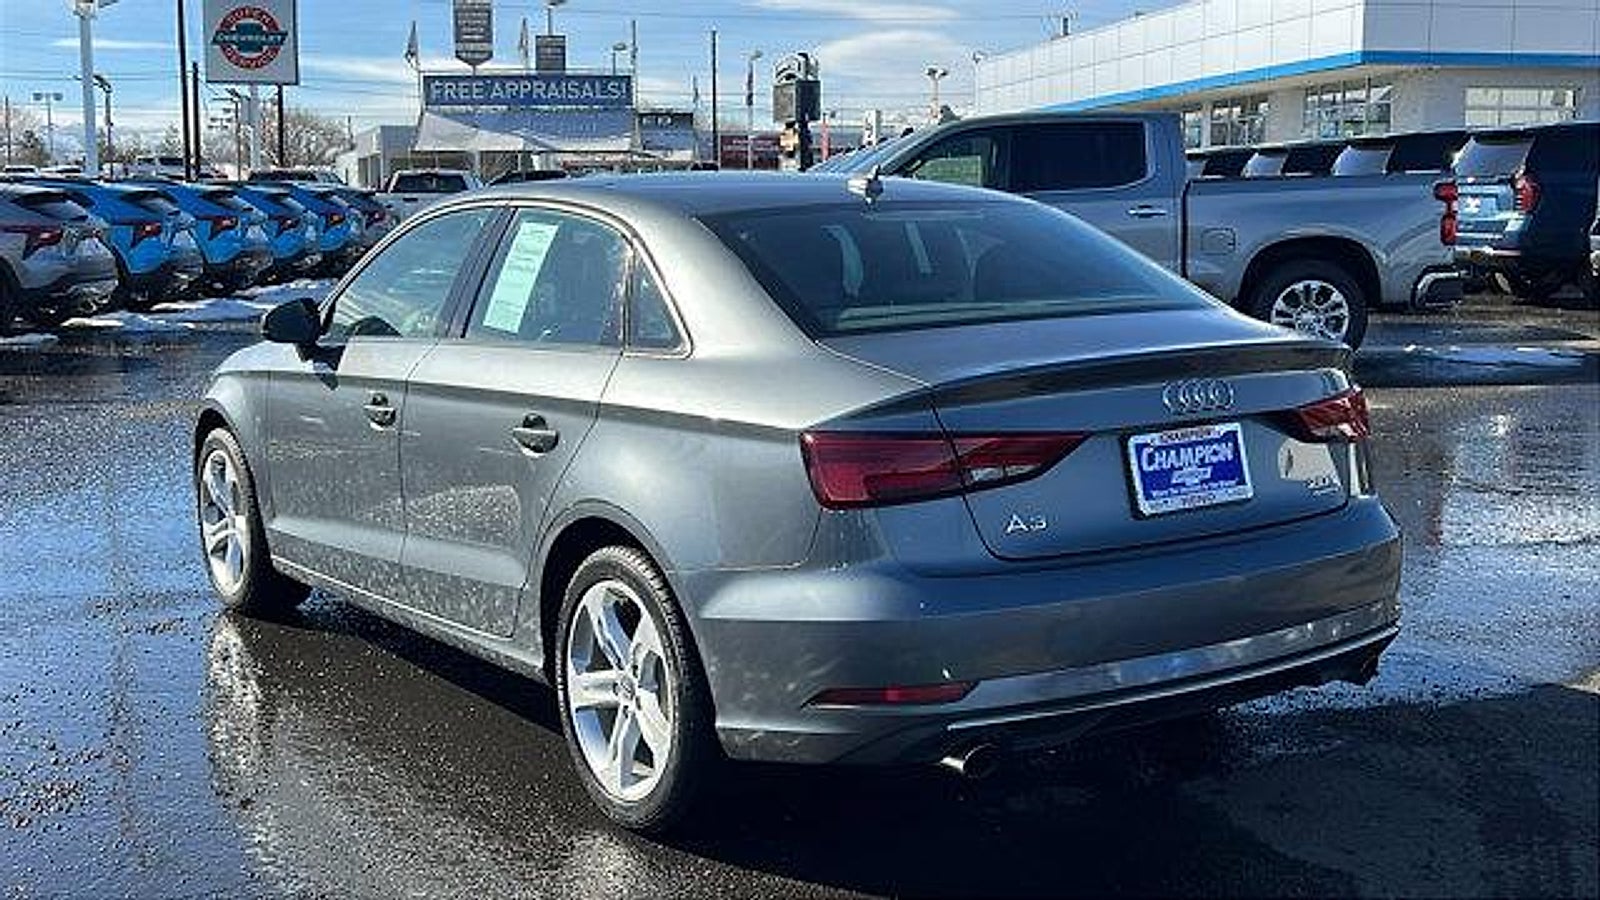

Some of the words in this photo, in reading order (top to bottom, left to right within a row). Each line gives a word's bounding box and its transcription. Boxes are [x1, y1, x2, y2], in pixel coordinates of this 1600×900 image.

[215, 32, 281, 41] CHEVROLET
[429, 80, 484, 100] FREE
[491, 80, 628, 100] APPRAISALS!
[1141, 442, 1234, 471] CHAMPION
[1006, 513, 1048, 533] A3
